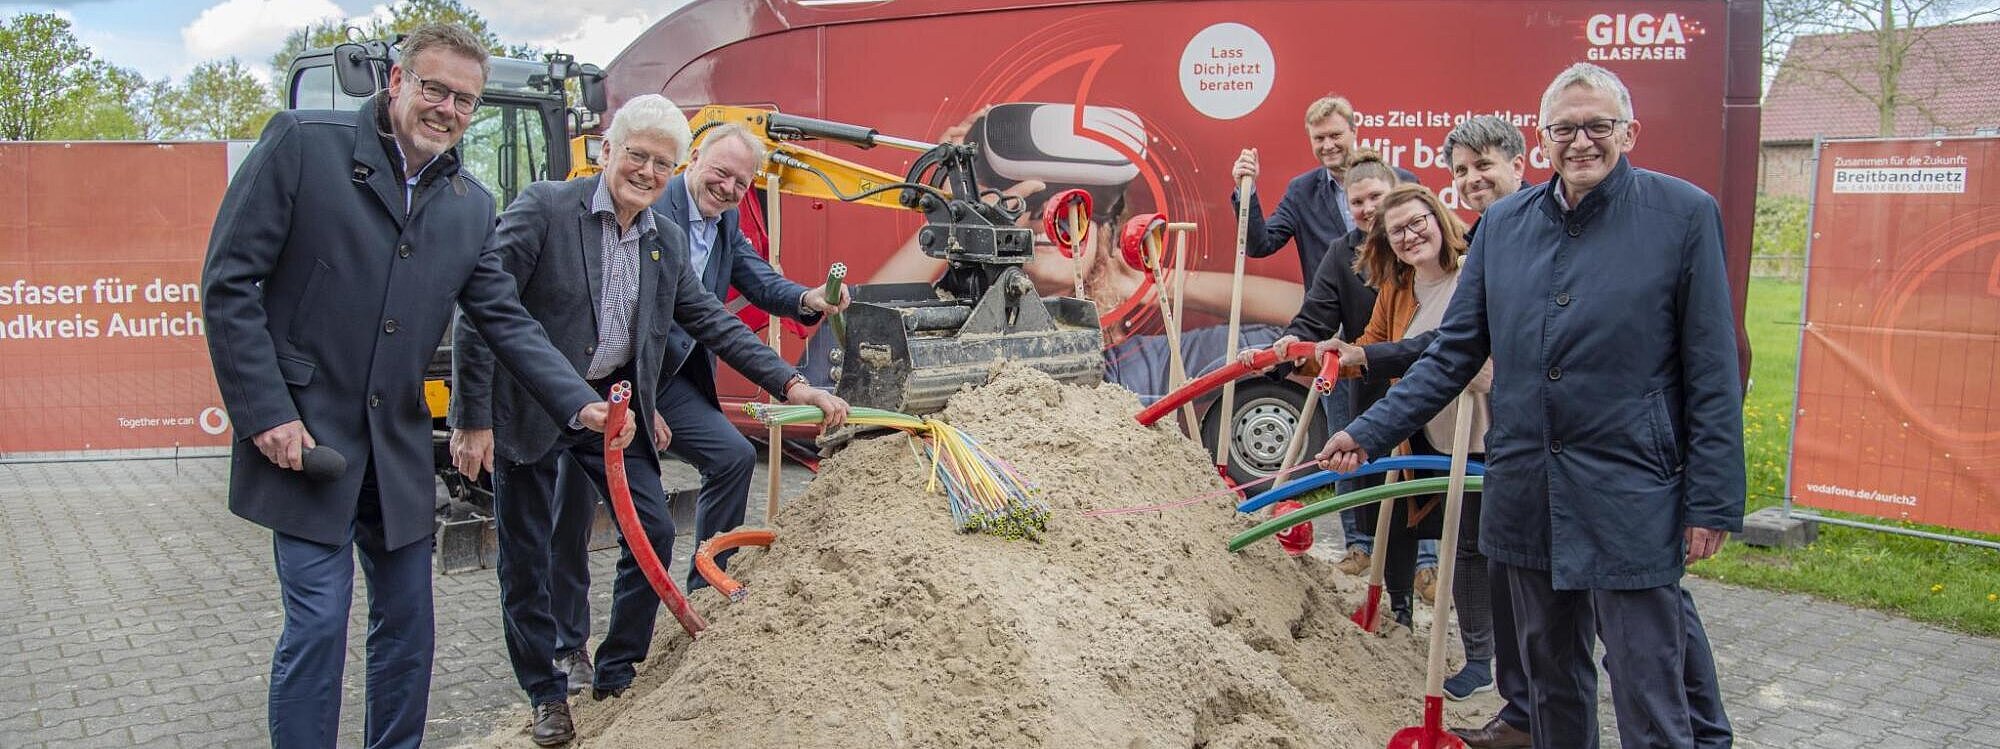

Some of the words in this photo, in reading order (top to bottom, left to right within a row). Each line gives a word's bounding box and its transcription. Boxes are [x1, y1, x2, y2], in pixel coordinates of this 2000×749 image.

[1586, 13, 1686, 45] GIGA
[1211, 47, 1243, 59] Lass
[1587, 47, 1686, 60] GLASFASER
[1194, 63, 1224, 75] Dich
[1227, 62, 1261, 77] jetzt
[1200, 80, 1253, 91] beraten
[1352, 111, 1385, 127] Das
[1387, 110, 1423, 127] Ziel
[1427, 110, 1451, 127] ist
[1834, 157, 1888, 167] Zusammen
[1890, 155, 1905, 165] für
[1906, 156, 1922, 165] die
[1836, 169, 1962, 183] Breitbandnetz
[1852, 184, 1913, 192] LANDKREIS
[1918, 183, 1962, 192] AURICH
[93, 278, 138, 304] für
[144, 277, 200, 303] den
[106, 311, 205, 338] Aurich
[118, 417, 160, 429] Together
[161, 417, 177, 426] we
[178, 416, 194, 425] can
[1807, 484, 1917, 506] vodafone.de/aurich2
